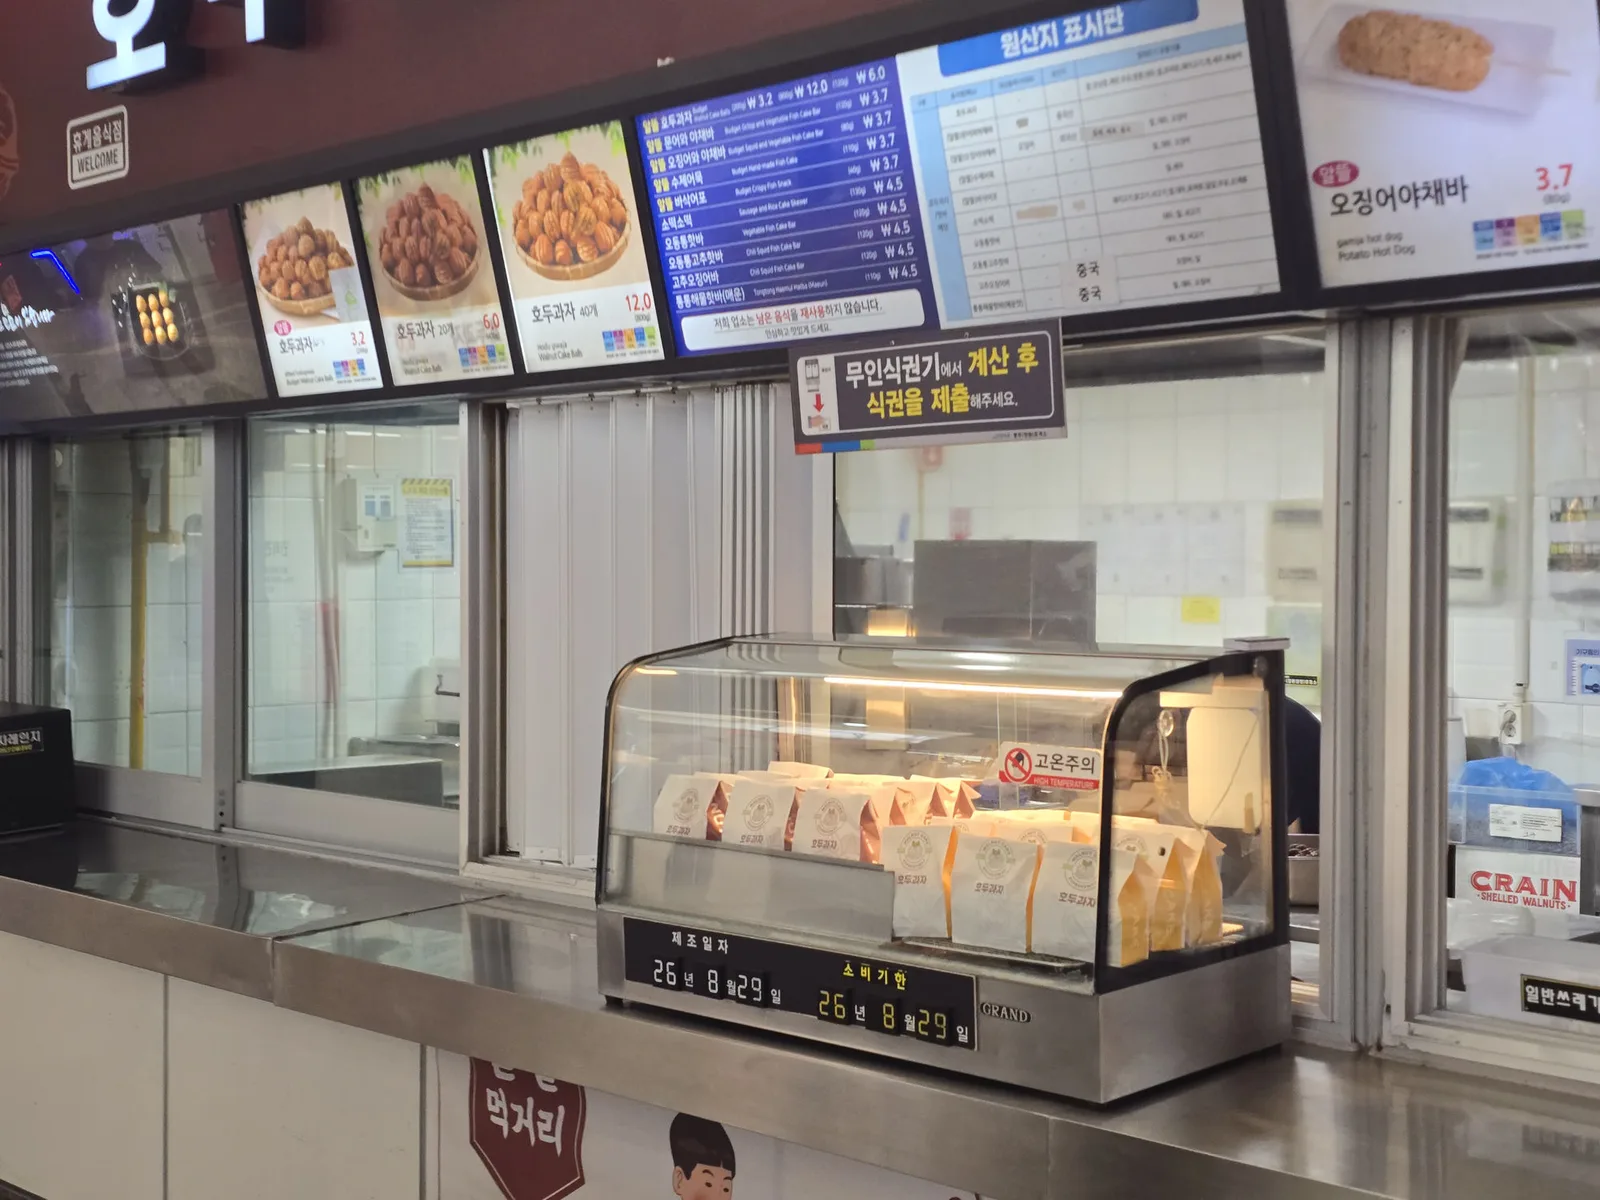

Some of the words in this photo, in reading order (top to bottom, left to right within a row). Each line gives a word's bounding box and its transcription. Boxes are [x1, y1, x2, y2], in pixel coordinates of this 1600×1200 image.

[1000, 23, 1060, 59] 원산지
[1064, 6, 1125, 45] 표시판
[660, 109, 692, 130] 호두과자
[72, 119, 123, 153] 휴게음식점
[663, 131, 689, 150] 문어와
[77, 148, 119, 174] WELCOME
[666, 149, 700, 170] 오징어와
[1536, 163, 1574, 192] 3.7
[1329, 175, 1469, 217] 오징어야채바
[660, 212, 693, 232] 소떡소떡
[1338, 247, 1371, 262] Potato
[1373, 245, 1391, 256] Hot
[1393, 243, 1416, 256] Dog
[670, 269, 720, 290] 고추오징어바
[1075, 260, 1101, 279] 중국
[625, 292, 652, 313] 12.0
[1077, 285, 1103, 303] 중국
[483, 312, 500, 330] 6.0
[532, 300, 576, 324] 호두과자
[579, 303, 599, 319] 40개
[713, 316, 730, 331] 저희
[730, 313, 756, 329] 업소는
[755, 310, 773, 326] 남은
[773, 307, 799, 323] 음식을
[798, 302, 843, 320] 재사용하지
[842, 297, 883, 315] 않습니다.
[351, 330, 366, 346] 3.2
[397, 319, 436, 341] 호두과자
[438, 321, 455, 338] 20개
[279, 335, 313, 355] 호두과자
[539, 350, 557, 362] Walnut
[558, 349, 571, 360] Cake
[571, 348, 583, 359] Balls
[846, 351, 963, 389] 무인식권기에서
[968, 344, 1010, 378] 계산
[1016, 341, 1040, 374] 후
[866, 385, 924, 419] 식권을
[930, 383, 1019, 415] 제출해주세요.
[1034, 753, 1096, 775] 고온주의
[1033, 777, 1049, 786] HIGH
[1049, 778, 1095, 790] TEMPERATURE
[896, 874, 928, 885] 호두과자
[974, 881, 1005, 895] 호두과자
[1470, 869, 1577, 903] CRAIN
[1057, 891, 1096, 908] 호두과자
[1481, 891, 1519, 906] SHELLED
[1522, 895, 1567, 911] WALNUTS
[653, 959, 677, 986] 26
[683, 971, 694, 988] 년
[707, 969, 719, 994] 8
[726, 979, 737, 996] 월
[737, 974, 762, 1001] 29
[770, 988, 781, 1005] 일
[819, 990, 847, 1020] 26
[854, 1005, 865, 1022] 년
[882, 1003, 895, 1029] 8
[904, 1014, 916, 1032] 월
[918, 1009, 947, 1040] 29
[956, 1025, 969, 1043] 일
[981, 1003, 1030, 1023] GRAND
[486, 1087, 565, 1158] 먹거리
